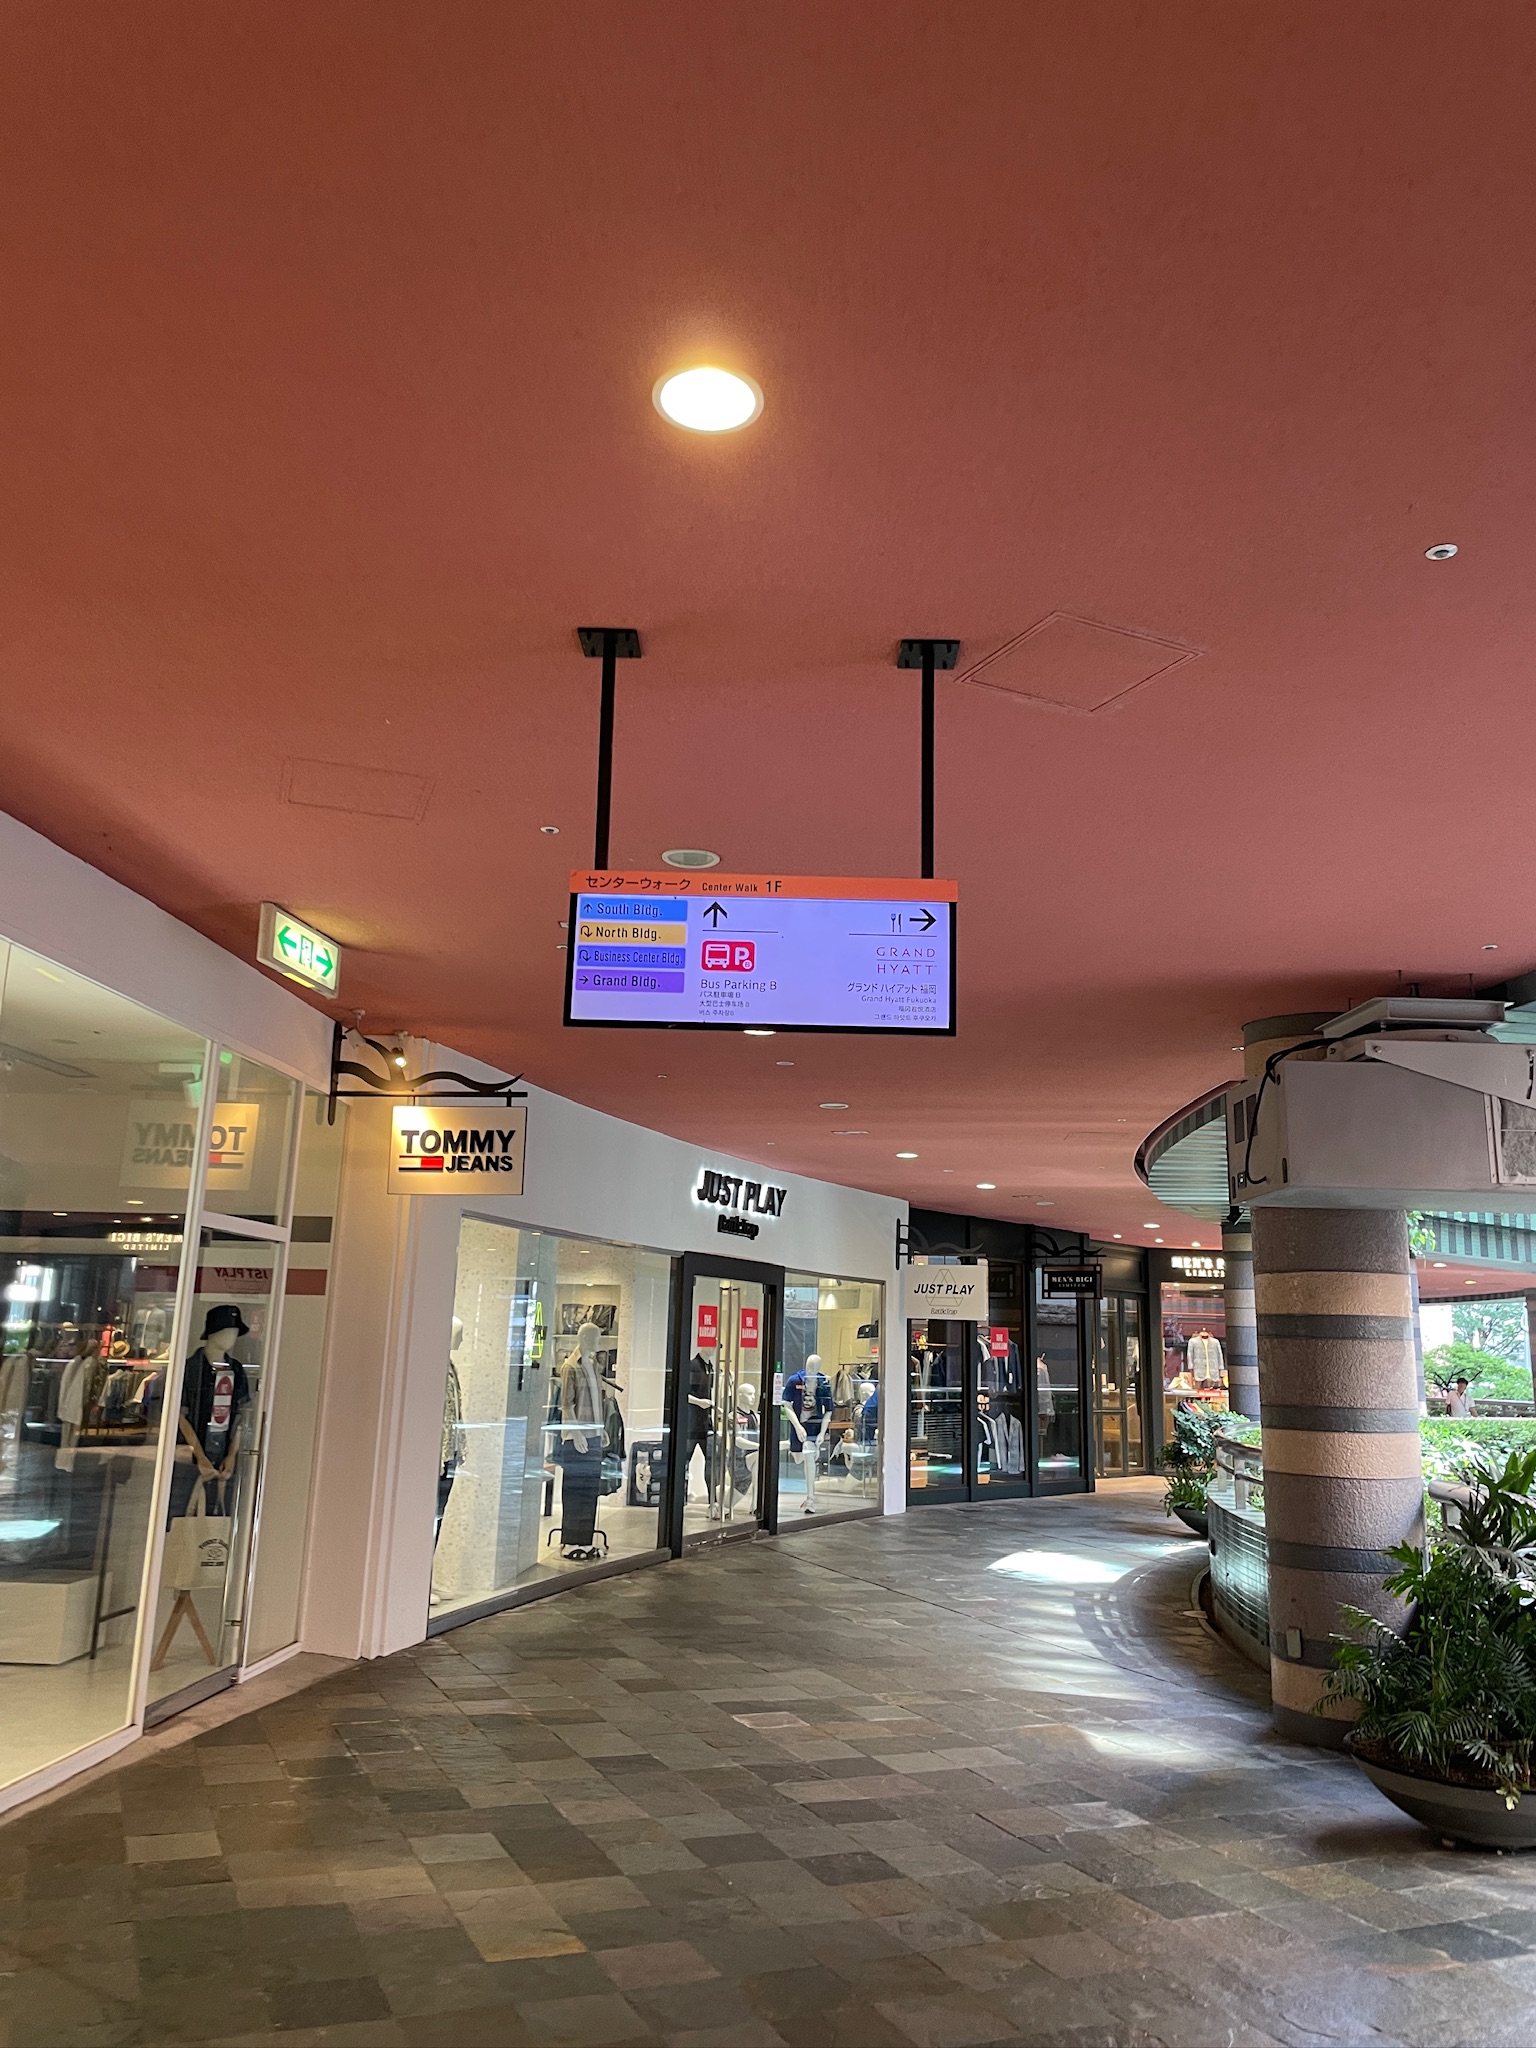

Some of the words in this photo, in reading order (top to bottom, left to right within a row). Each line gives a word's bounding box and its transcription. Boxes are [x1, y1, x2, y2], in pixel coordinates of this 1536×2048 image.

[586, 875, 691, 891] センターウォーク
[702, 882, 732, 892] Center
[735, 882, 758, 892] Walk
[765, 880, 782, 892] 1F
[597, 902, 629, 915] South
[633, 903, 663, 918] Bldg.
[595, 926, 628, 939] North
[632, 927, 661, 941] Bldg.
[594, 950, 631, 963] Business
[633, 951, 660, 963] Center
[662, 952, 683, 966] Bldg.
[876, 947, 936, 957] GRAND
[877, 964, 935, 975] HYATT
[593, 974, 627, 987] Grand
[631, 975, 661, 989] Bldg.
[700, 979, 720, 989] Bus
[724, 979, 766, 992] Parking
[769, 981, 777, 990] B
[847, 982, 878, 992] グランド
[880, 983, 918, 993] ハイアット
[920, 984, 937, 994] 福岡
[885, 996, 905, 1004] Hyatt
[401, 1129, 516, 1155] TOMMY
[445, 1155, 514, 1174] JEANS
[697, 1170, 743, 1208] JUST
[743, 1181, 788, 1217] PLAY
[1171, 1255, 1214, 1269] MEN'S
[913, 1283, 944, 1295] JUST
[945, 1284, 976, 1295] PLAY
